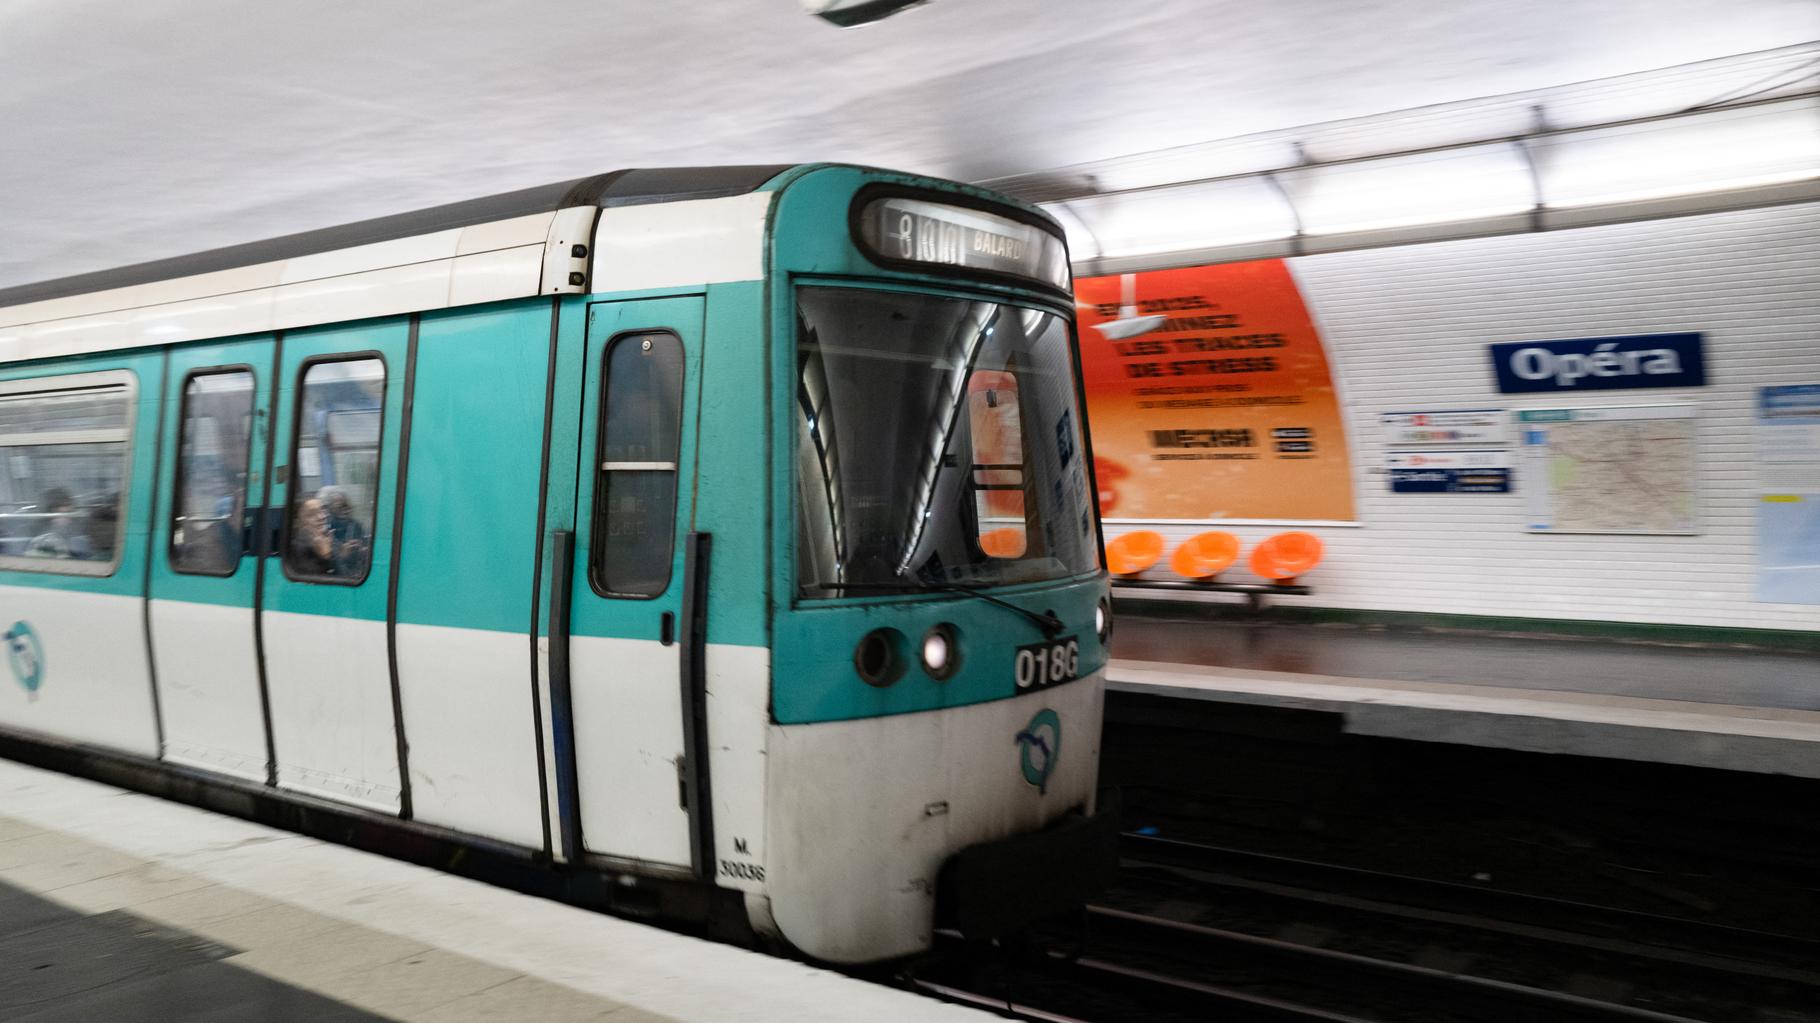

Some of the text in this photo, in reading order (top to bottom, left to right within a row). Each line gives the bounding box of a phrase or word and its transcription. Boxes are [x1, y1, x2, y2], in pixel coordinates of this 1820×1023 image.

[974, 230, 1021, 259] BALARD
[1511, 344, 1682, 386] Opéra
[1015, 641, 1078, 688] 018G
